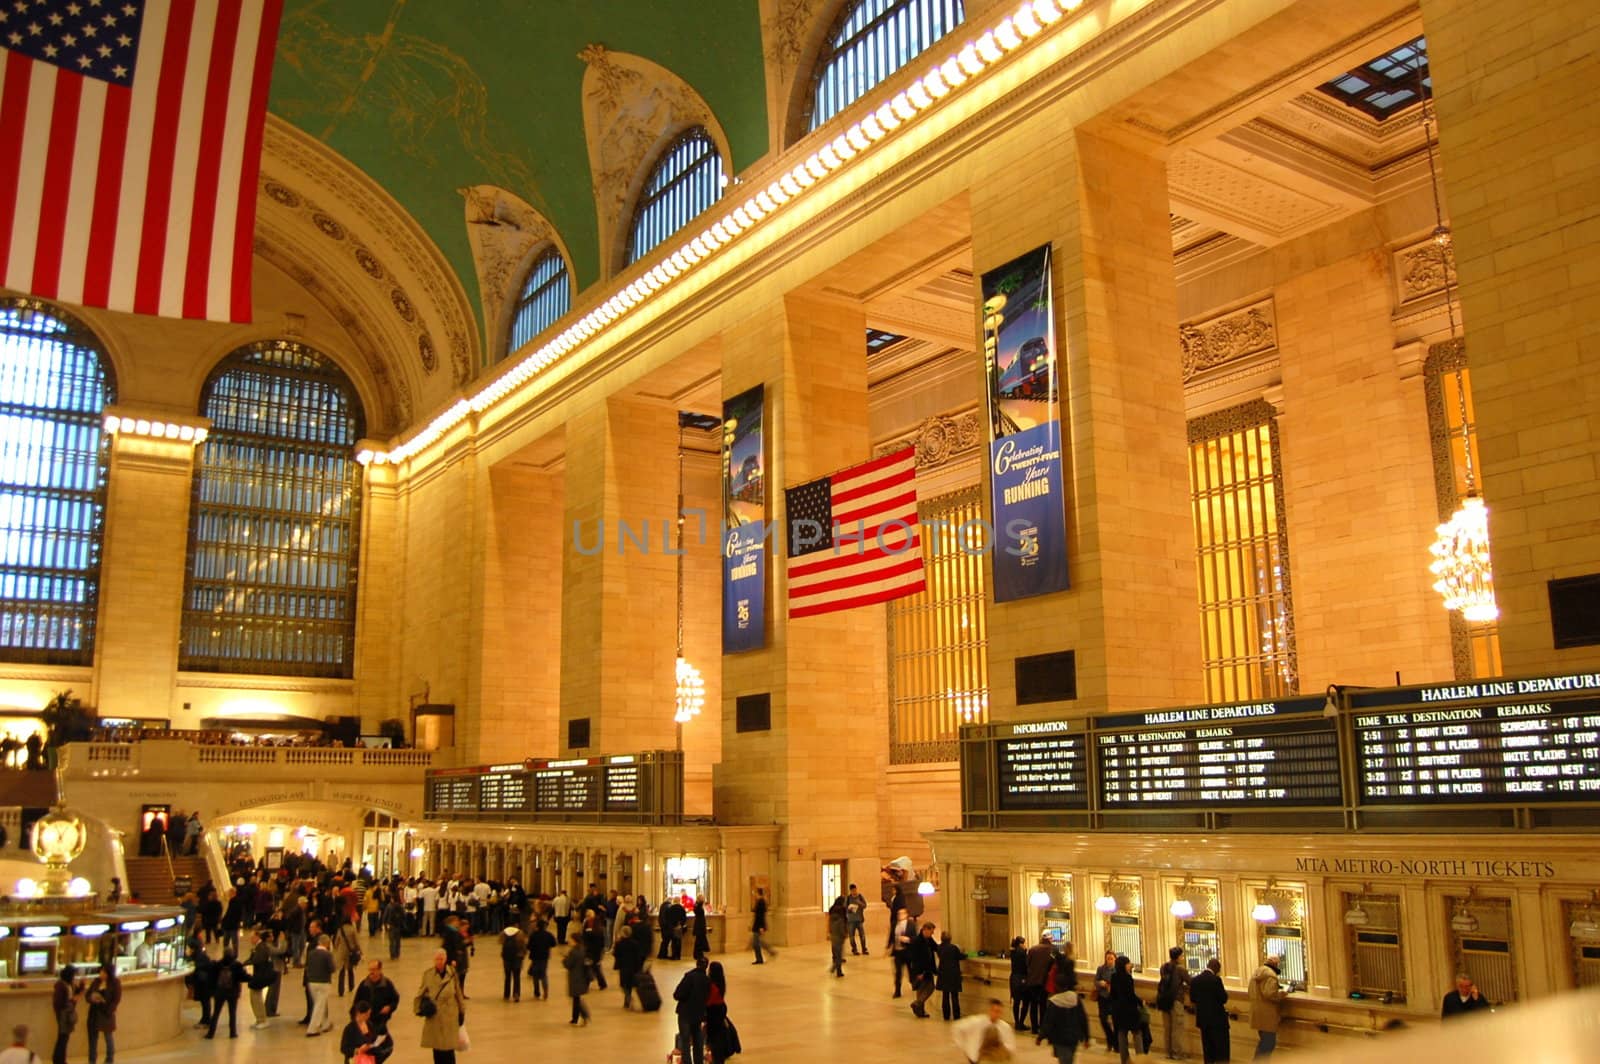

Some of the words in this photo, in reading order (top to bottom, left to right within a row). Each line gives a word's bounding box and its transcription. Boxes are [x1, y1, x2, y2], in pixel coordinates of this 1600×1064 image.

[994, 440, 1044, 475] Celebrating
[1011, 450, 1060, 471] TWENTY-FIVE
[1022, 466, 1050, 486] Years
[1004, 477, 1049, 505] RUNNING
[1421, 684, 1478, 702] HARLEM
[1481, 681, 1515, 697] LINE
[1144, 711, 1184, 725] HARLEM
[1186, 709, 1209, 721] LINE
[1211, 703, 1276, 719] DEPARTURES
[1357, 716, 1380, 727] TIME
[1386, 714, 1408, 725] TRK
[1412, 709, 1482, 723] DESTINATION
[1497, 703, 1551, 717] REMARKS
[1013, 721, 1068, 735] INFORMATION
[1100, 735, 1116, 744] TIME
[1138, 731, 1187, 742] DESTINATION
[1196, 727, 1233, 738] REMARKS
[1364, 731, 1381, 741] 2:51
[1416, 727, 1439, 737] MOUNT
[1443, 725, 1468, 736] KISCO
[1563, 717, 1579, 728] 1ST
[1247, 738, 1263, 748] STOP
[1365, 744, 1383, 754] 2:55
[1449, 739, 1479, 750] PLAINS
[1554, 734, 1569, 744] 1ST
[1574, 732, 1598, 743] STOP
[1366, 758, 1384, 768] 3:17
[1397, 757, 1409, 767] 111
[1503, 751, 1530, 762] WHITE
[1534, 749, 1566, 761] PLAINS
[1583, 748, 1599, 758] 1ST
[1249, 764, 1265, 773] STOP
[1451, 768, 1481, 779] PLAINS
[1504, 767, 1520, 777] MT.
[1525, 765, 1558, 776] VERNON
[1561, 764, 1584, 775] WEST
[1249, 776, 1266, 786] STOP
[1453, 783, 1483, 793] PLAINS
[1505, 781, 1543, 792] MELROSE
[1559, 780, 1574, 790] 1ST
[1269, 789, 1285, 798] STOP
[1296, 858, 1329, 873] MTA
[1335, 858, 1466, 876] METRO-NORTH
[1472, 860, 1556, 878] TICKETS
